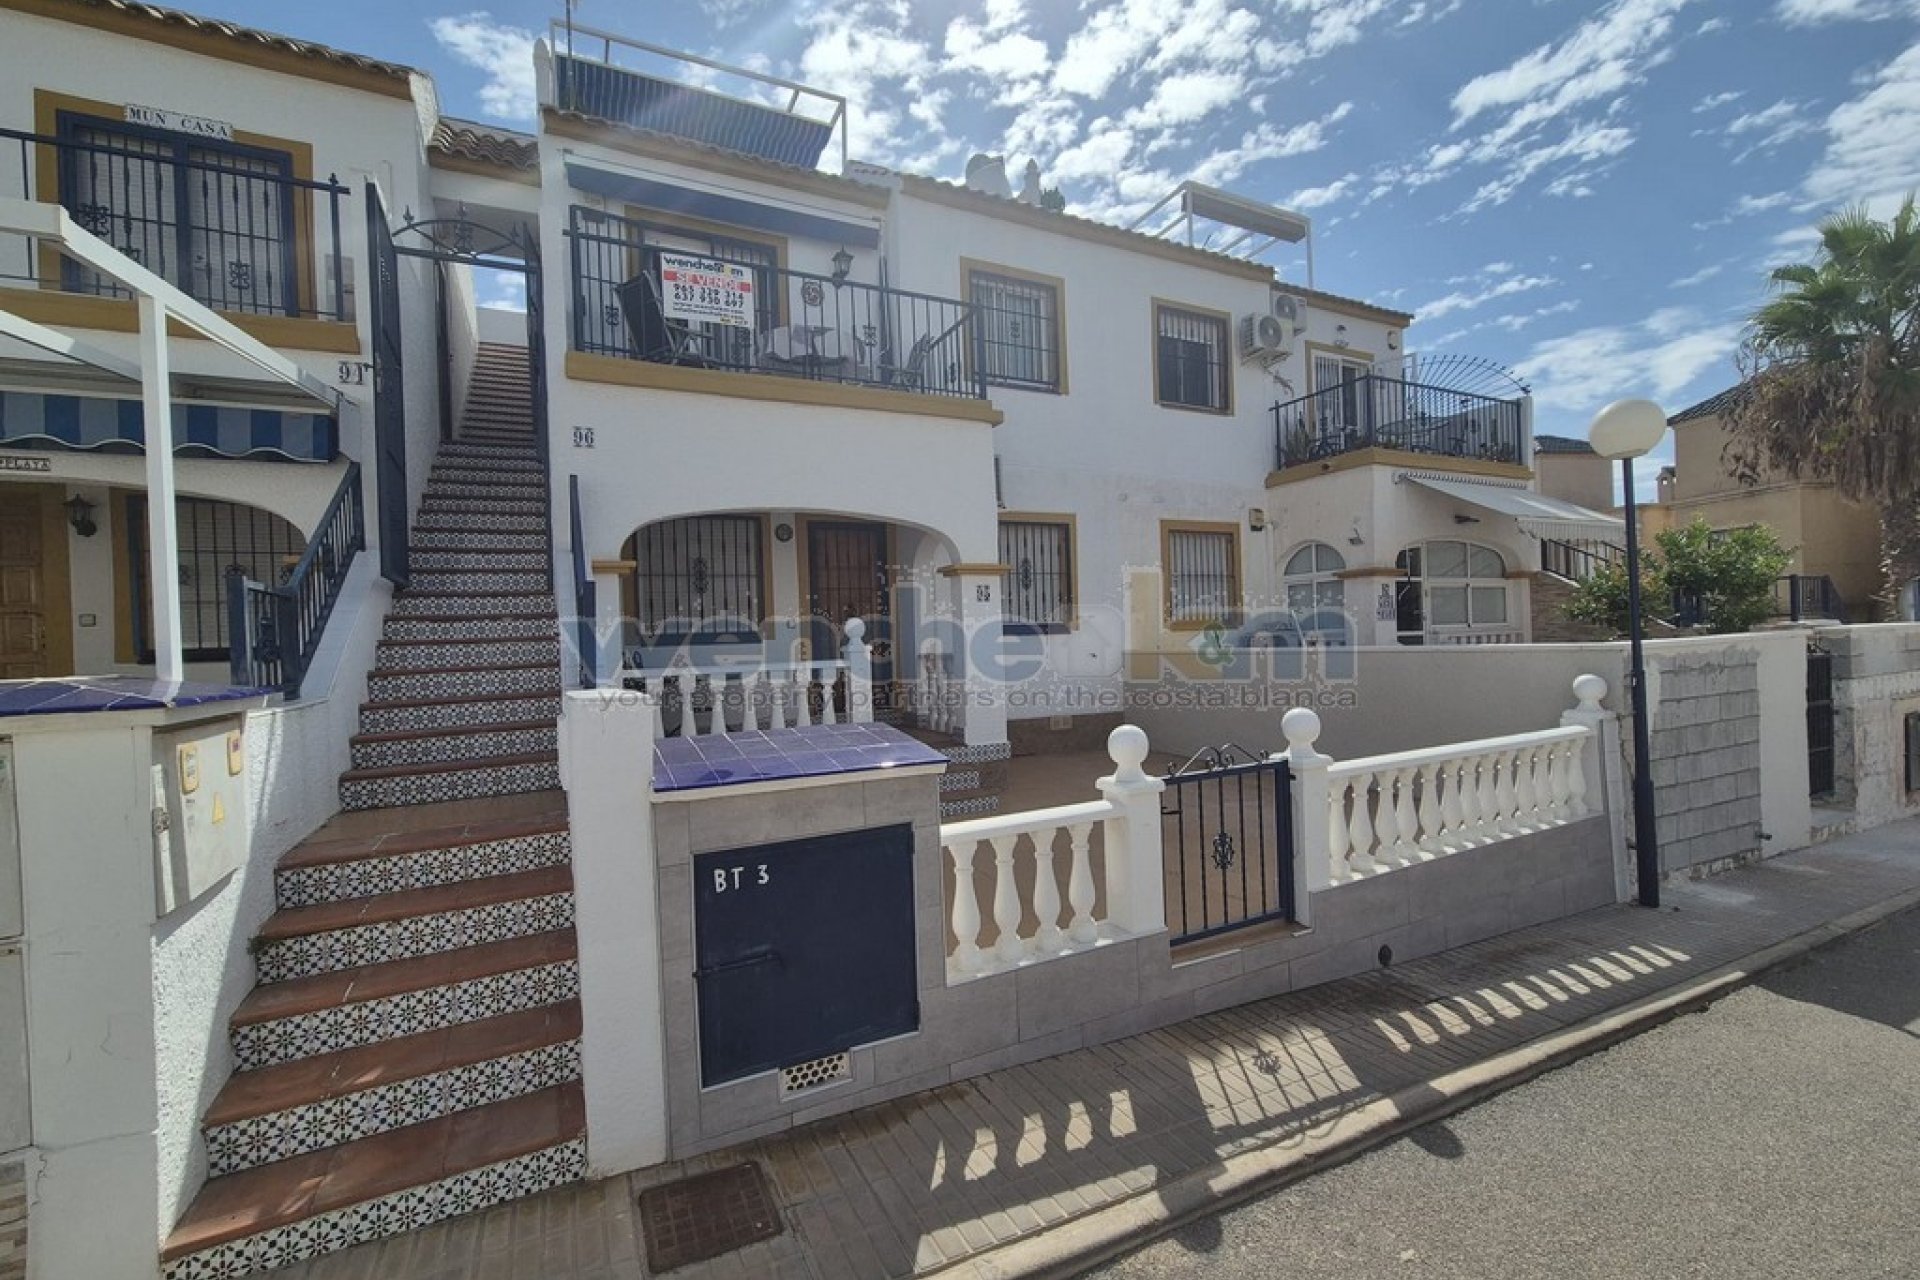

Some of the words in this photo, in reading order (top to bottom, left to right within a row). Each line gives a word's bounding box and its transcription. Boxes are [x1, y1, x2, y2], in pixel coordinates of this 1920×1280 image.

[180, 118, 229, 137] CASA
[573, 426, 595, 448] 96
[713, 866, 745, 893] BT
[757, 864, 770, 885] 3
